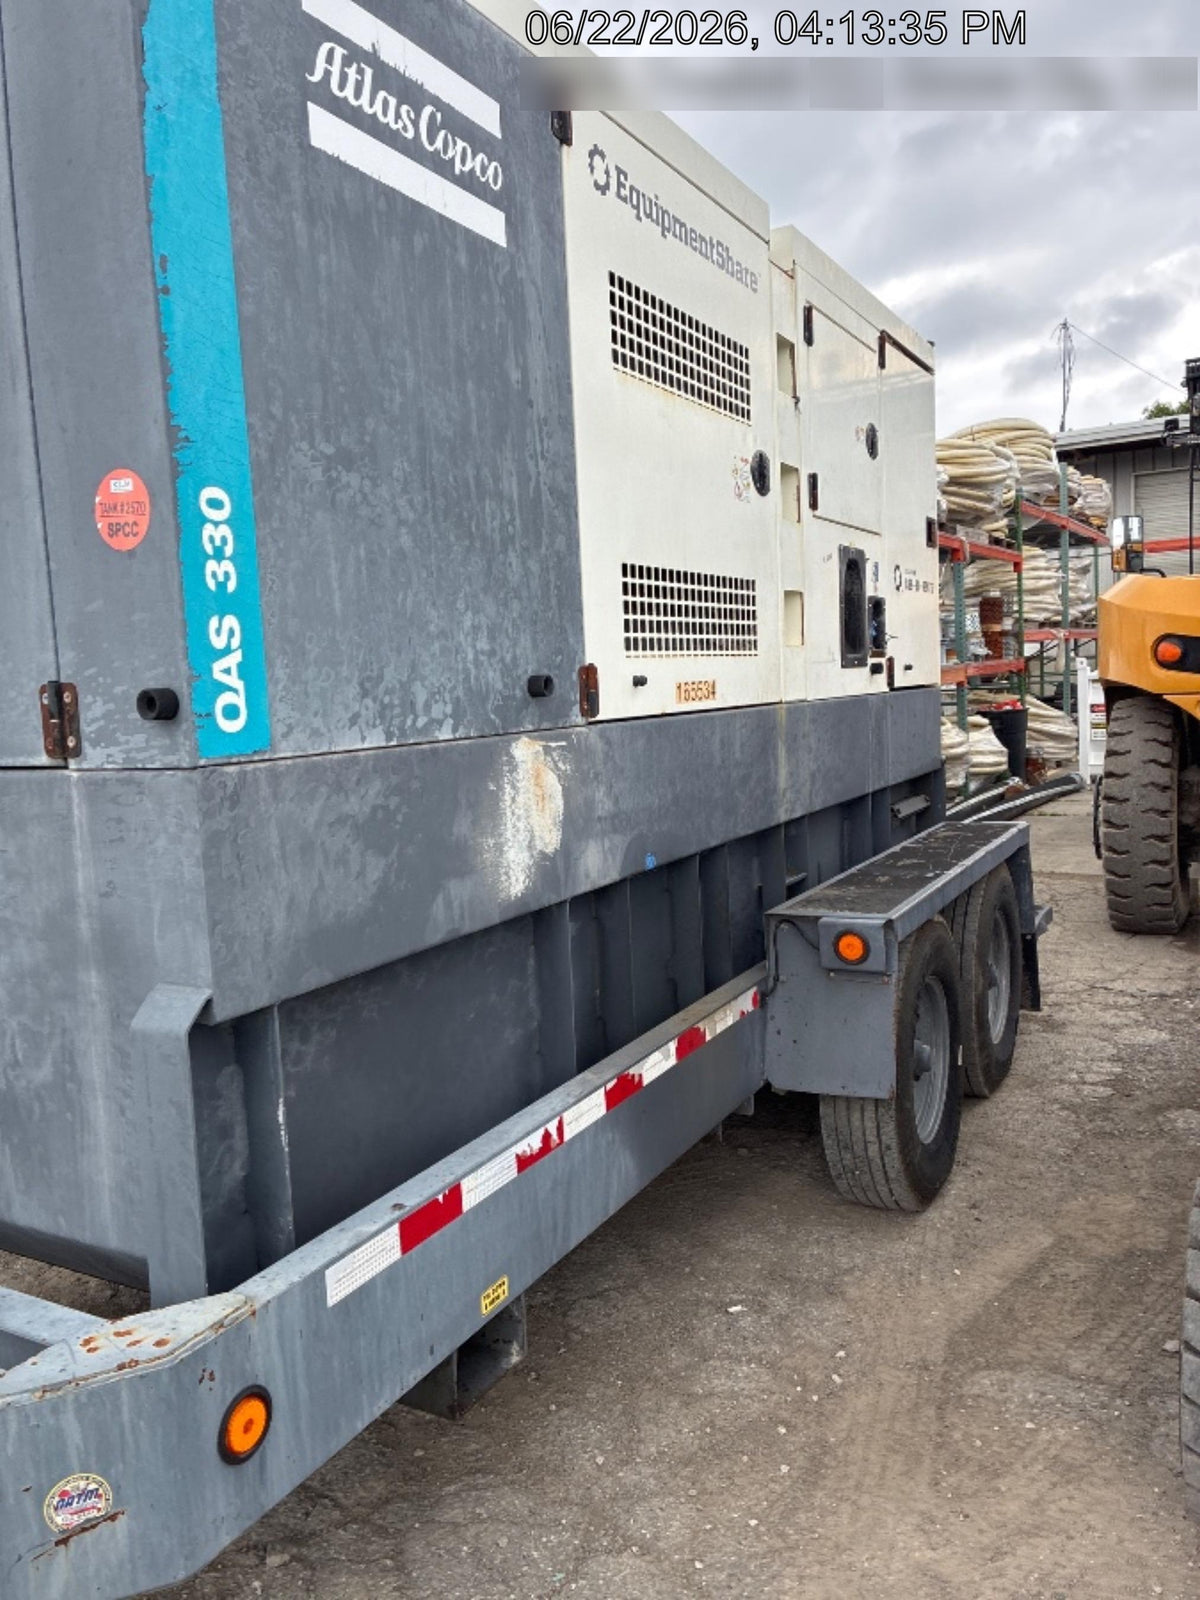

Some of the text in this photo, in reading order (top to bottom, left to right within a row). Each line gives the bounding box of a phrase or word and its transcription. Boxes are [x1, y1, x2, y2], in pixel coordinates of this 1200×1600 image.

[305, 42, 503, 191] Atlas Copco
[614, 164, 759, 293] EquipmentShare
[107, 520, 140, 539] SPCC
[199, 485, 248, 733] QAS 330
